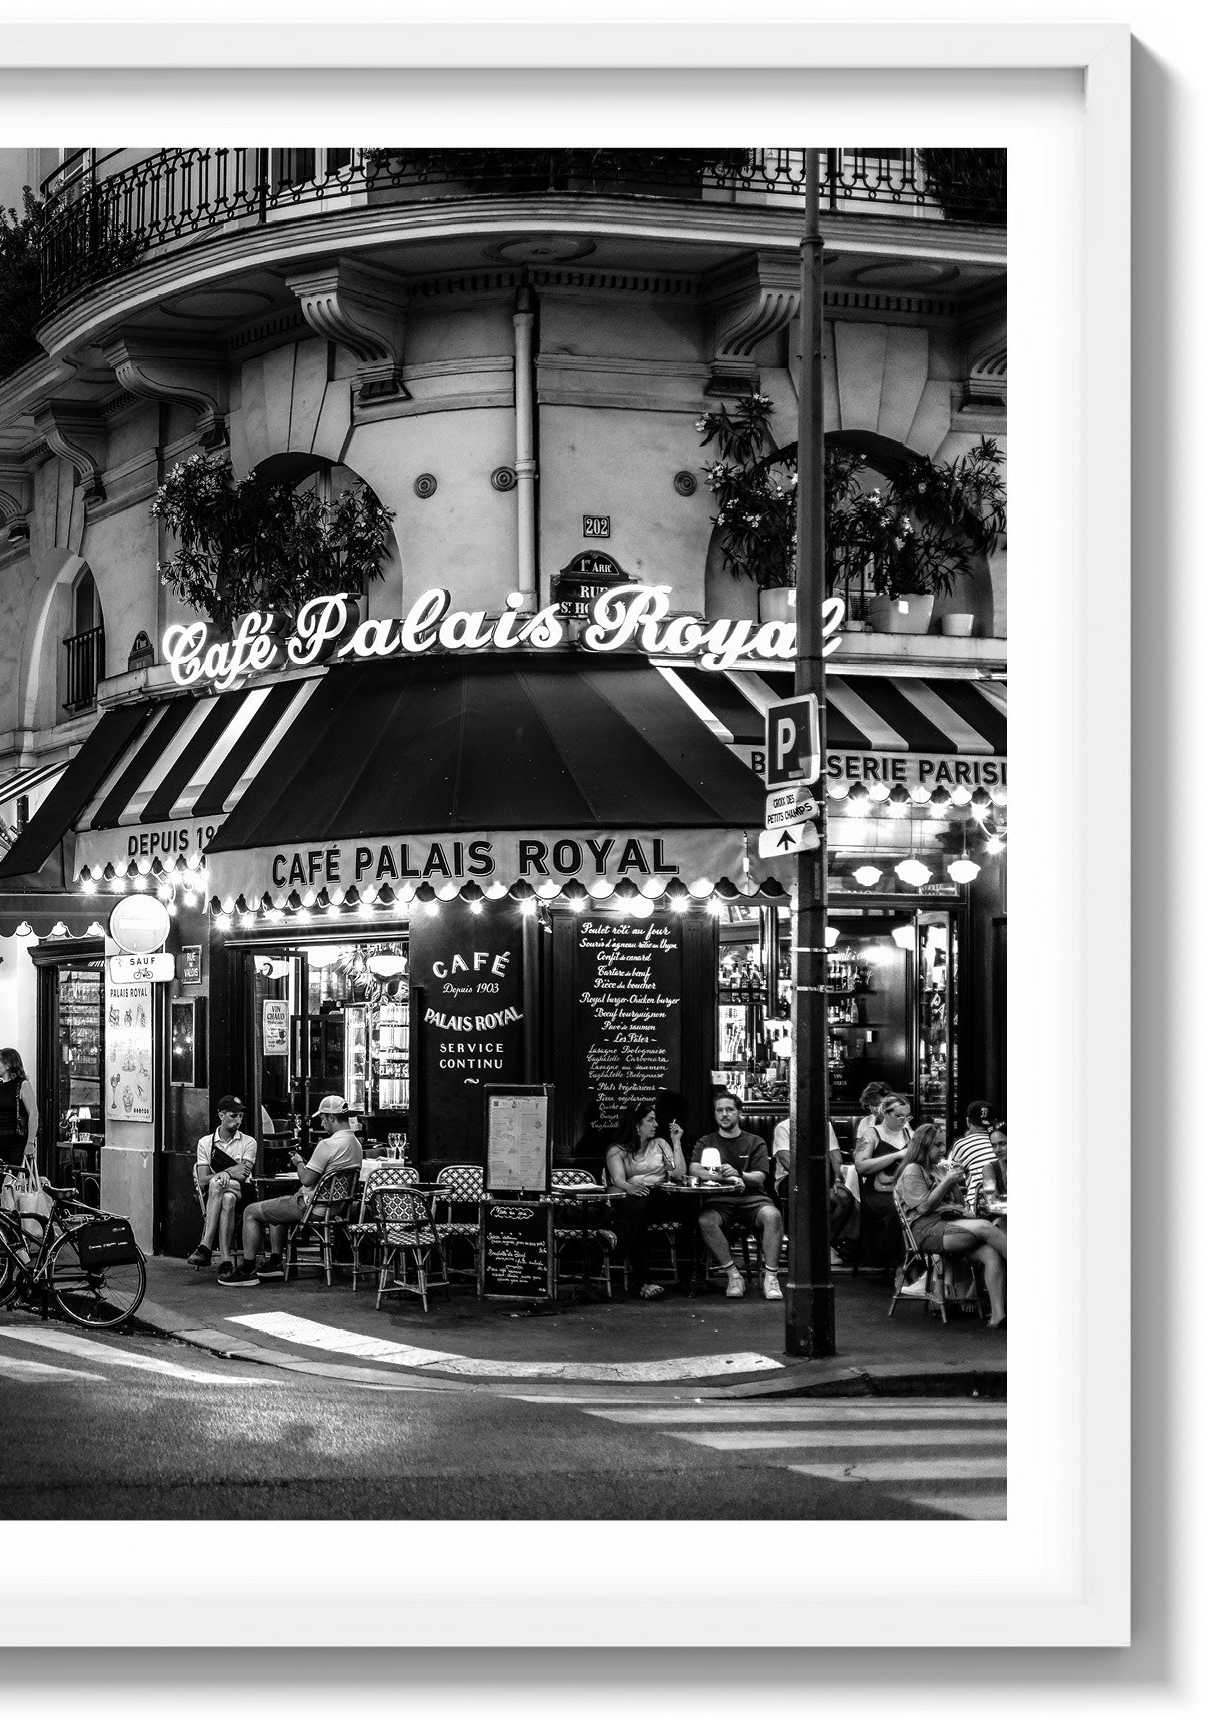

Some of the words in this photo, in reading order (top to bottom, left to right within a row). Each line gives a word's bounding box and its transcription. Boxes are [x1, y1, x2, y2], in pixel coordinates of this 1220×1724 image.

[586, 518, 608, 535] 202
[162, 611, 278, 690] Café
[288, 588, 563, 665] Palais
[777, 717, 796, 770] P
[751, 751, 907, 782] BSERIE
[786, 794, 795, 804] DES
[767, 812, 784, 824] PETITS
[785, 802, 813, 820] CHAMPS
[128, 828, 189, 857] DEPUIS
[271, 844, 342, 888] CAFÉ
[355, 840, 496, 882] PALAIS
[519, 838, 681, 877] ROYAL
[581, 922, 611, 934] Poulet
[645, 923, 671, 940] four
[130, 957, 155, 965] SAUF
[432, 951, 511, 978] CAFÉ
[597, 951, 620, 966] Confit
[626, 953, 651, 961] canard
[442, 982, 473, 998] Depuis
[476, 982, 499, 993] 1903
[627, 979, 656, 989] boucher
[110, 988, 128, 998] PALAIS
[130, 988, 148, 998] ROYAL
[580, 992, 606, 1007] Royal
[656, 994, 680, 1007] burger
[424, 1007, 473, 1032] PALAIS
[475, 1006, 524, 1031] ROYAL
[440, 1043, 504, 1053] SERVICE
[439, 1059, 503, 1069] CONTINU
